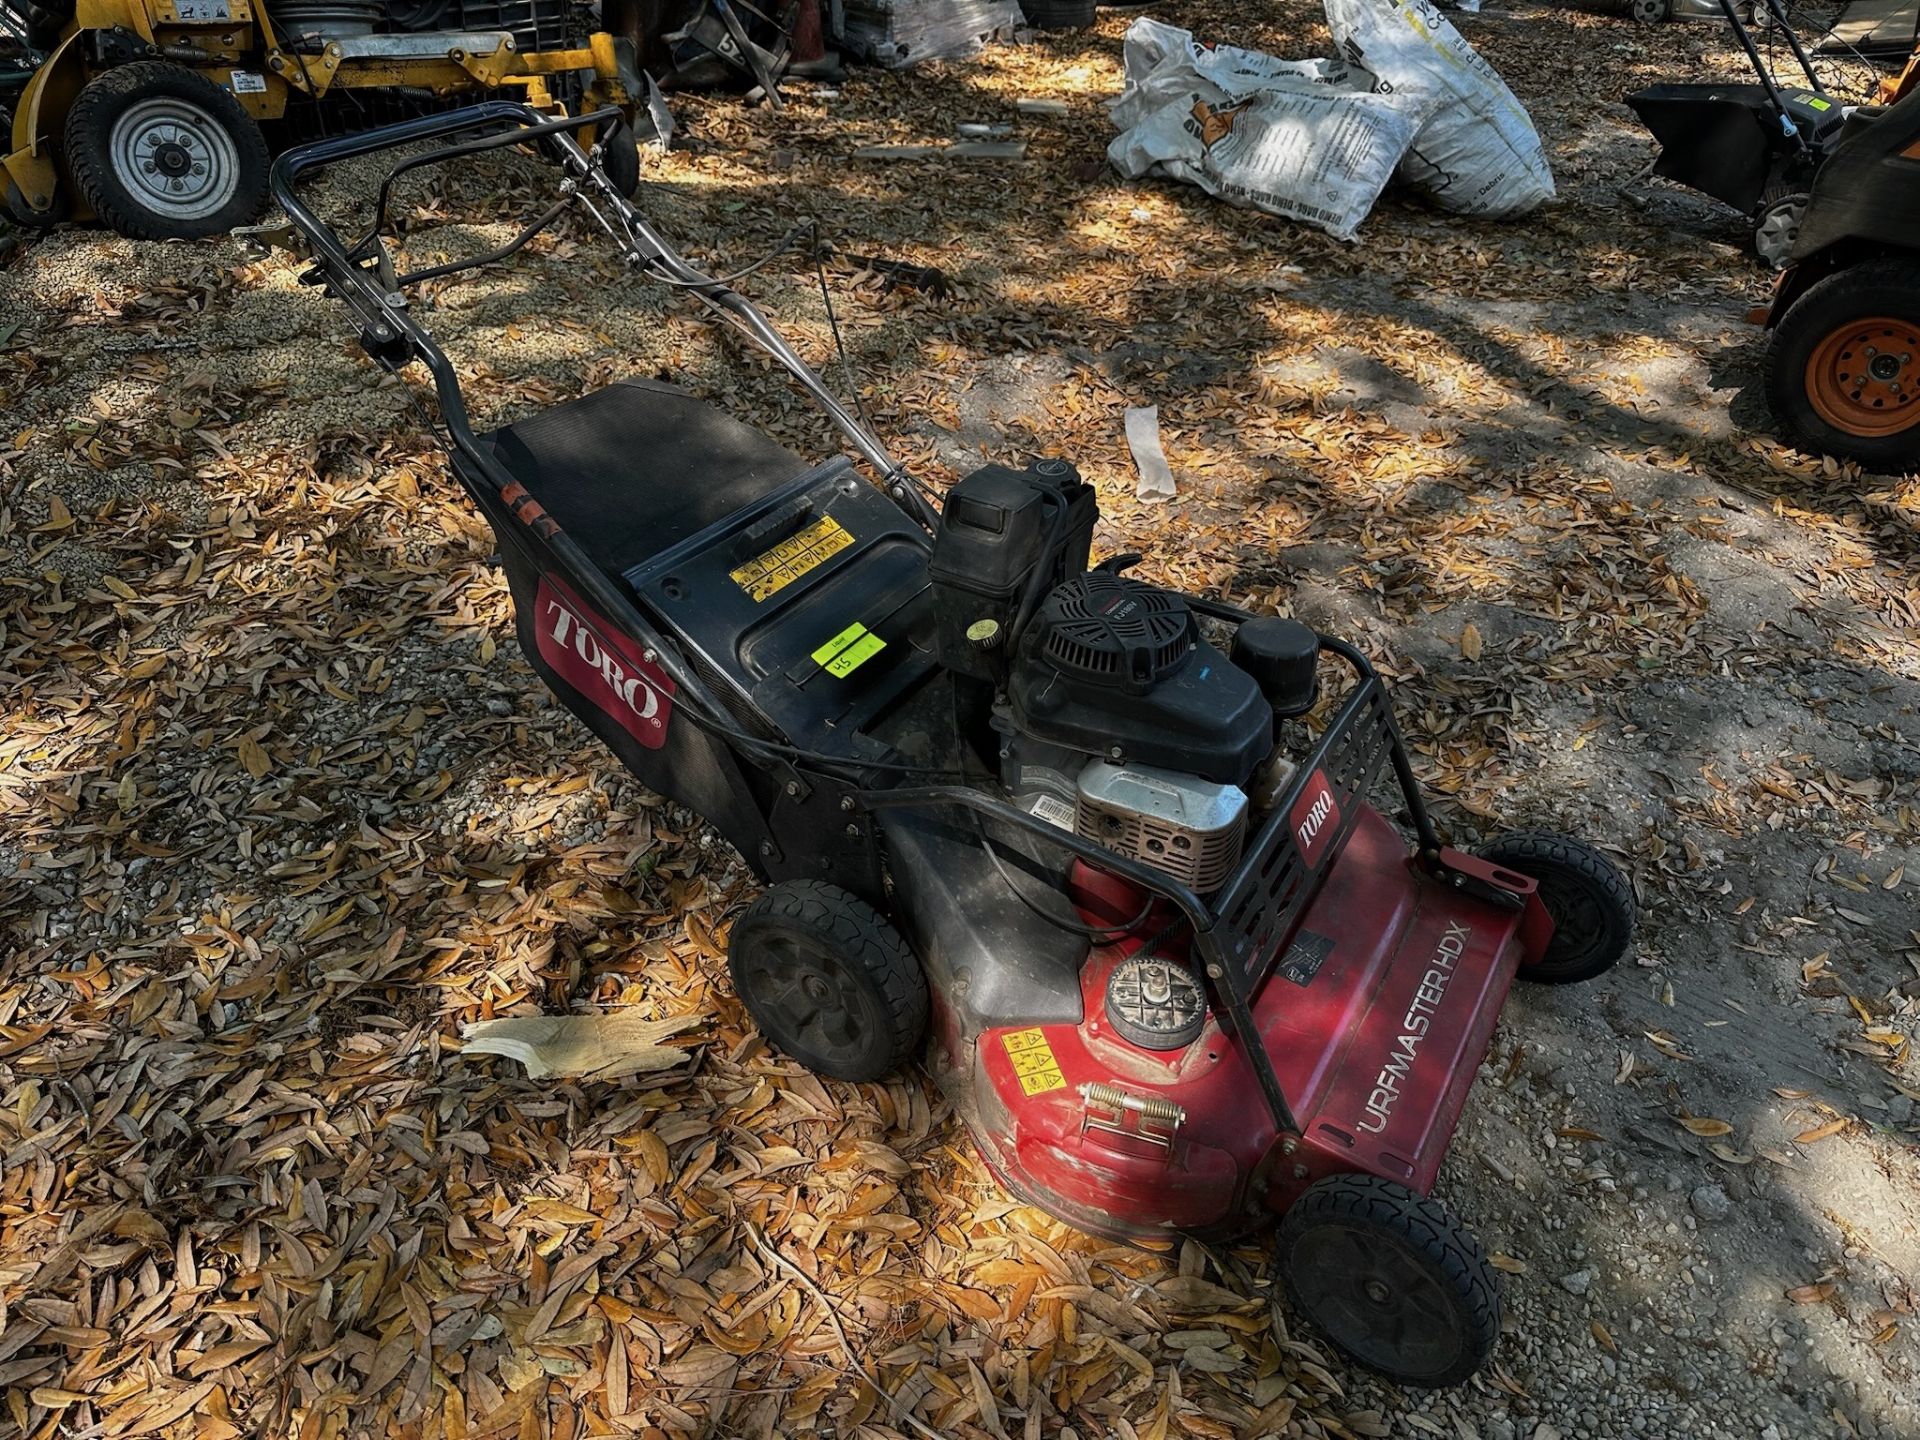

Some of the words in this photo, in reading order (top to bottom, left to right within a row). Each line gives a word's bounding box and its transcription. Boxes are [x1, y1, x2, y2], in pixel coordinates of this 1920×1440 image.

[1478, 172, 1505, 196] Debris
[1250, 188, 1273, 204] BAGS
[1271, 193, 1294, 211] DEMO
[1299, 202, 1320, 220] BAGS
[1318, 209, 1343, 226] DEMO
[833, 657, 852, 671] 45
[1298, 789, 1332, 849] TORO
[1356, 969, 1450, 1134] URFMASTER
[1432, 919, 1472, 971] HDX
